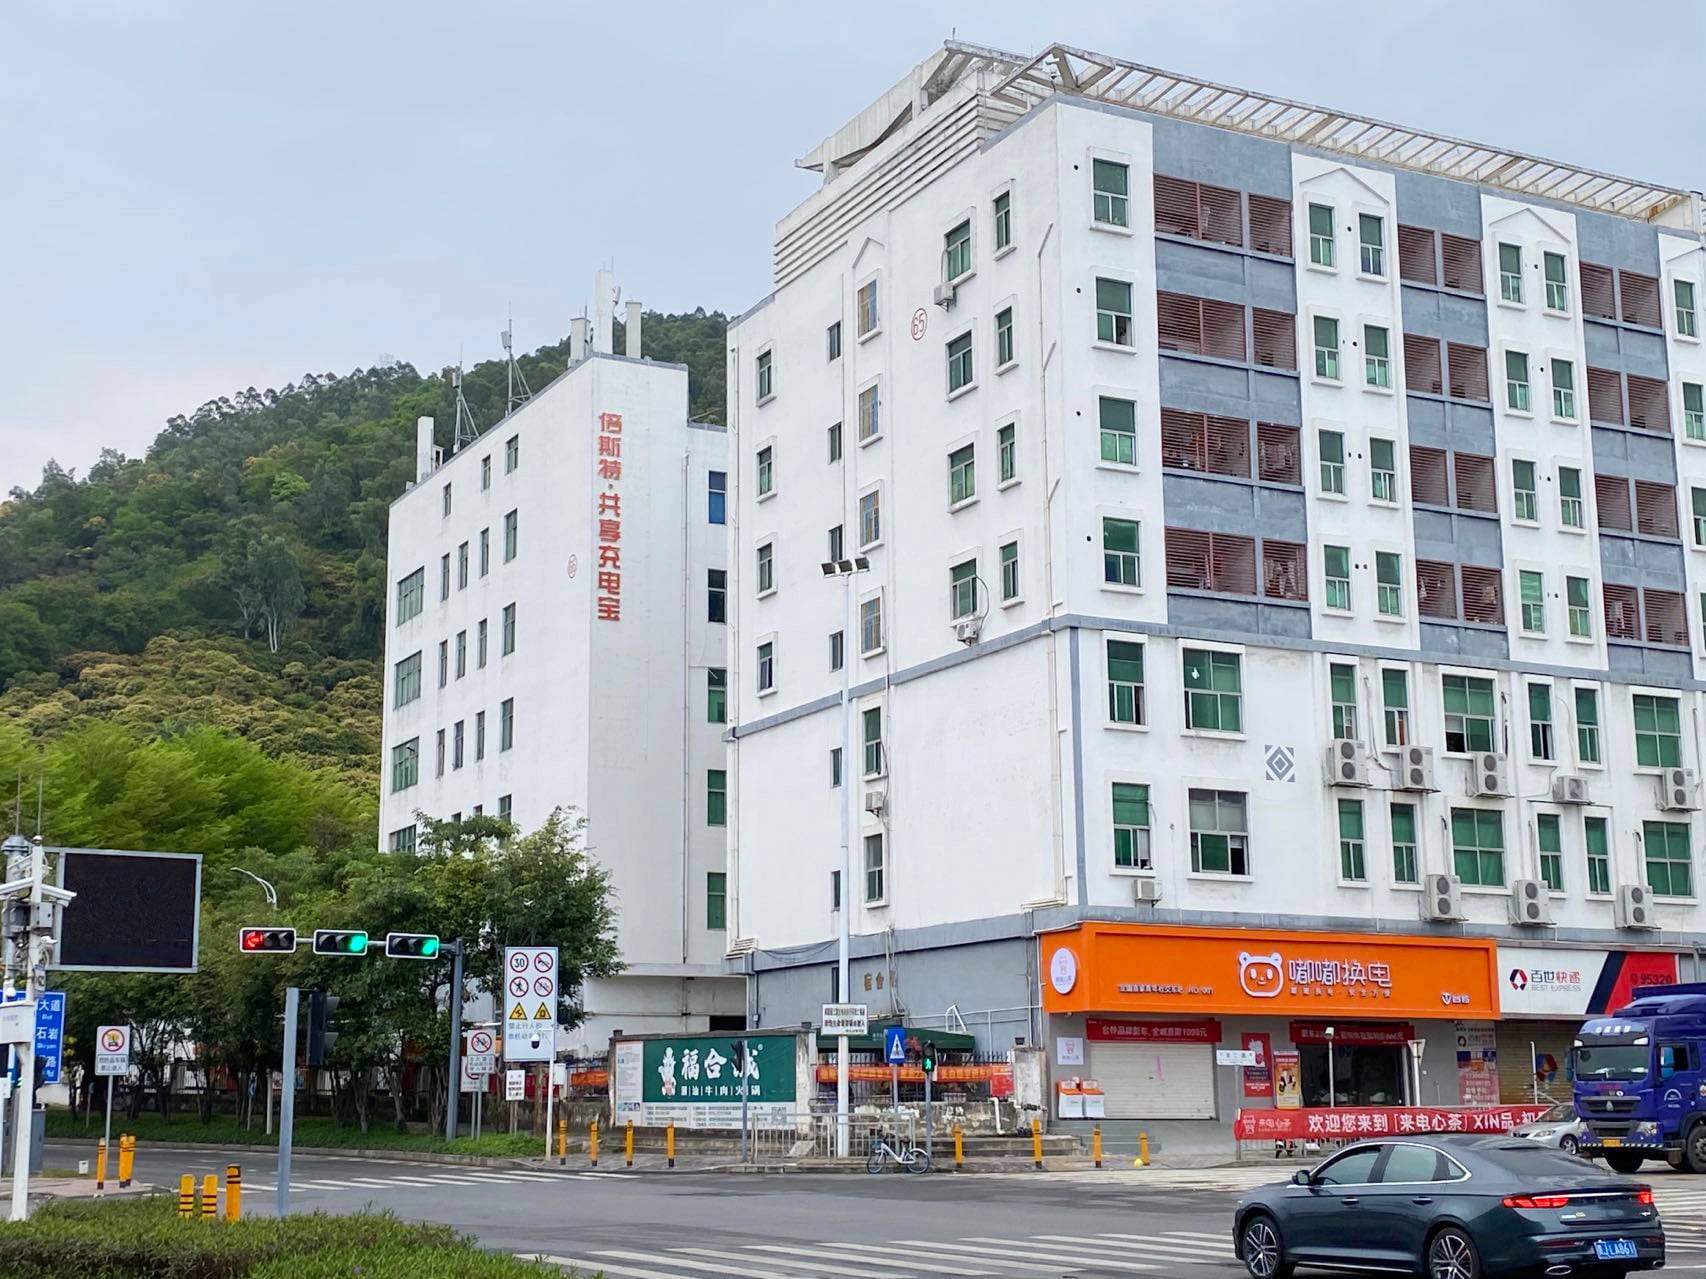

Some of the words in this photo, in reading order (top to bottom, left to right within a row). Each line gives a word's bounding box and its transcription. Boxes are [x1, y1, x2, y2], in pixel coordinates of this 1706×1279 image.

[913, 312, 925, 335] 65
[514, 958, 525, 968] 30
[1289, 958, 1393, 988] 嘟嘟换电
[1531, 969, 1581, 984] 百世快递
[1640, 973, 1672, 985] 95320
[39, 999, 60, 1012] 大道
[37, 1027, 58, 1040] 石岩
[1308, 1114, 1388, 1133] 欢迎您来到
